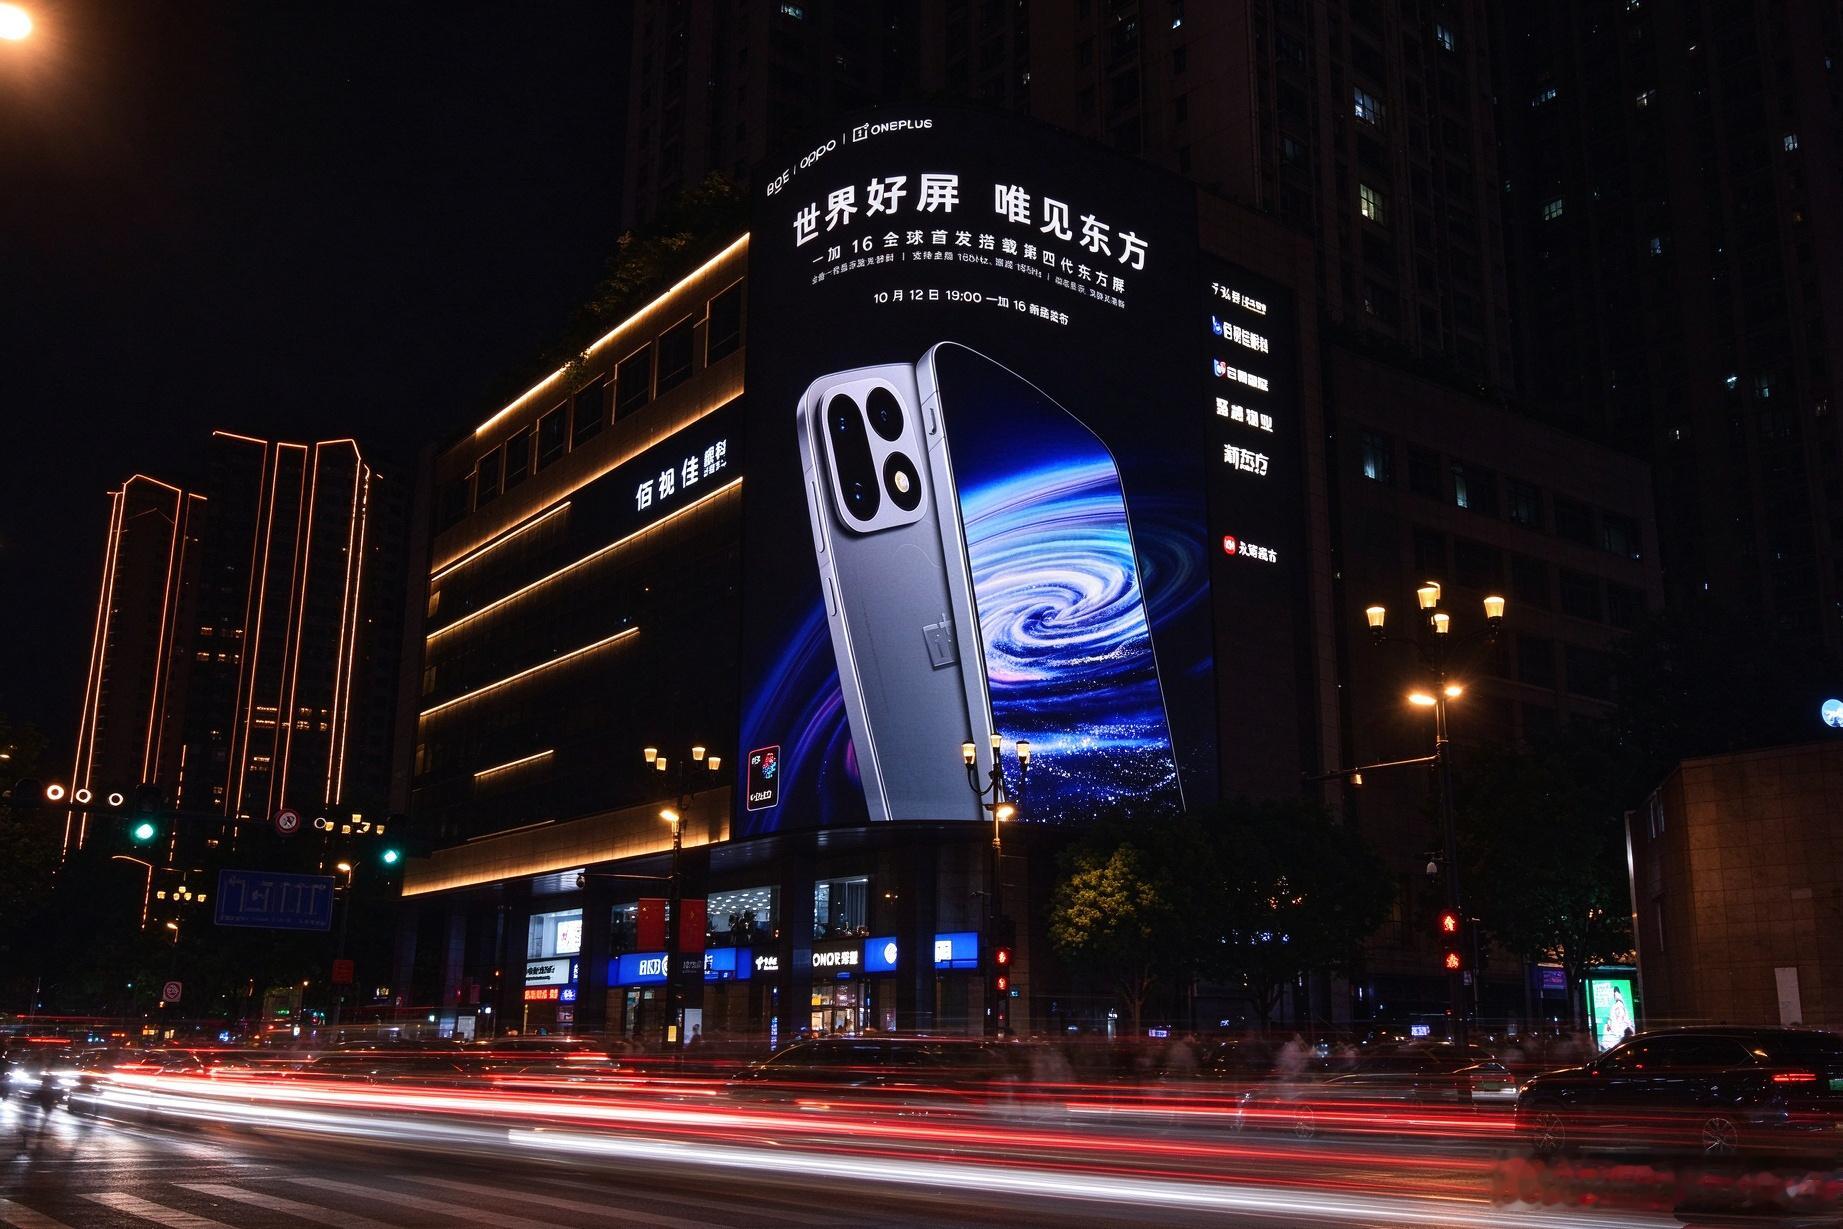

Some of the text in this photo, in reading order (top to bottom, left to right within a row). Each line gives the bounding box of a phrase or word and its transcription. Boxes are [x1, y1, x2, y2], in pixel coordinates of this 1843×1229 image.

[766, 168, 790, 197] BOE
[870, 119, 933, 136] ONEPLUS
[793, 173, 1150, 271] 世界好屏 唯见东方
[812, 245, 841, 263] 一加
[851, 235, 873, 254] 16
[883, 230, 1126, 294] 全球首发搭载第四代东方屏
[873, 291, 889, 304] 10
[892, 289, 904, 302] 月
[909, 289, 924, 301] 12
[928, 289, 940, 301] 日
[945, 289, 983, 304] 19:00
[985, 295, 1010, 309] 一加
[1013, 300, 1027, 313] 16
